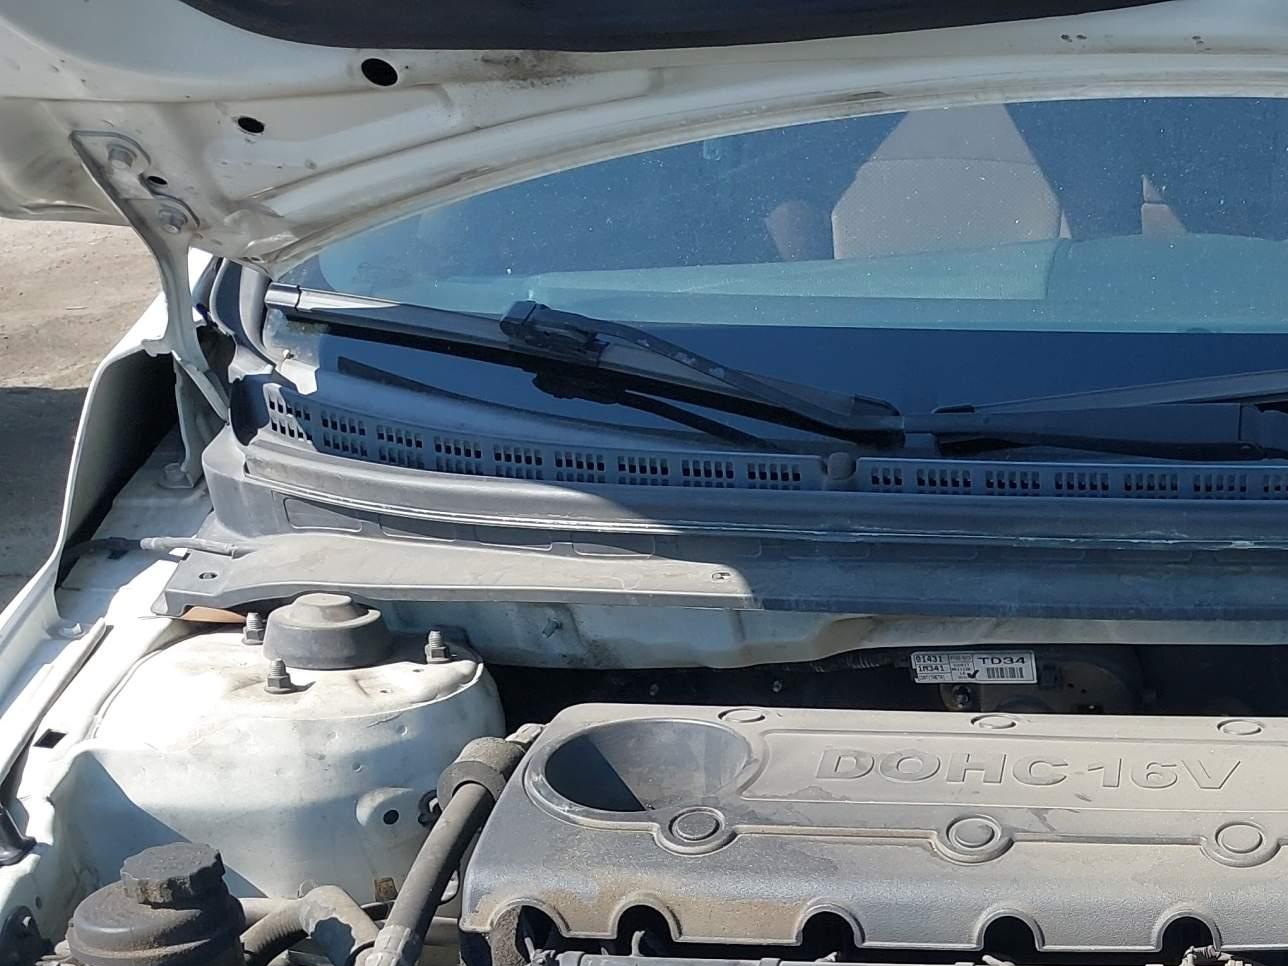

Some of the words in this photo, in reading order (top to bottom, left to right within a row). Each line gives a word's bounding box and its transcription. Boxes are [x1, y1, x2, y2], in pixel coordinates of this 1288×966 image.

[977, 656, 1026, 665] TD34
[816, 748, 1070, 787] DOHC
[1087, 758, 1241, 790] 16V
